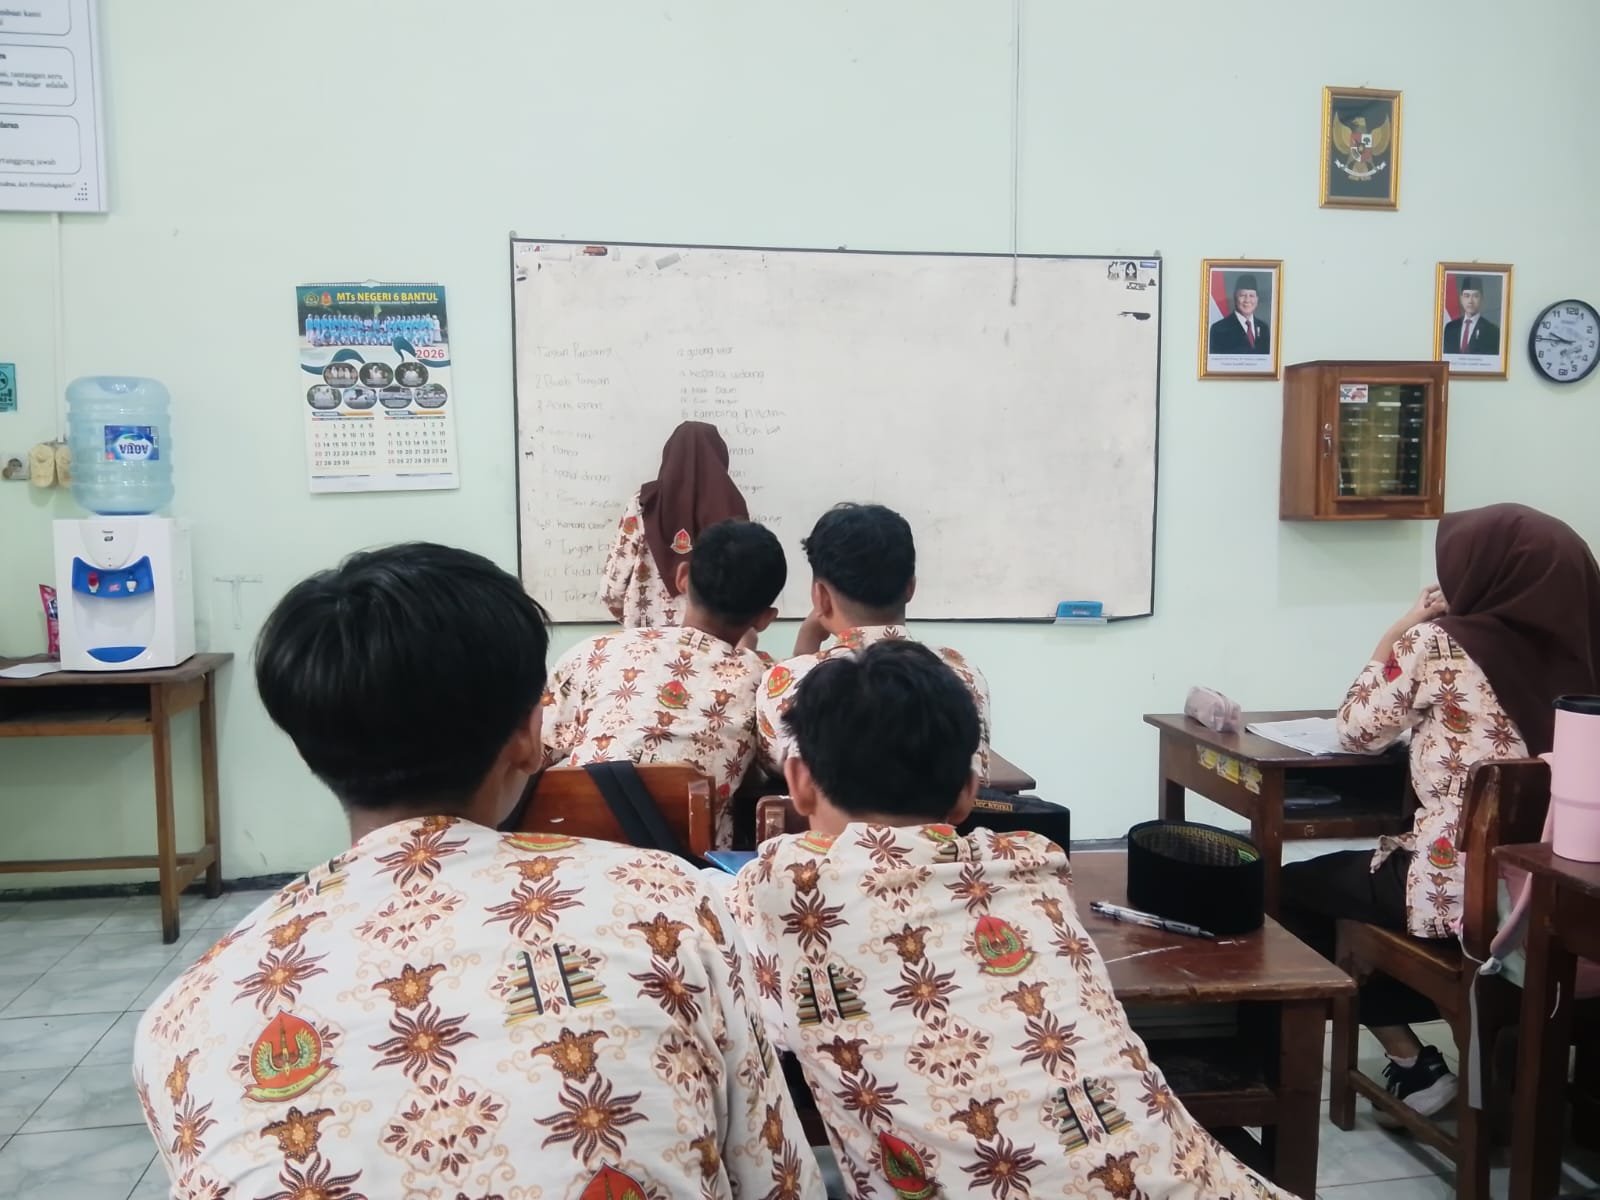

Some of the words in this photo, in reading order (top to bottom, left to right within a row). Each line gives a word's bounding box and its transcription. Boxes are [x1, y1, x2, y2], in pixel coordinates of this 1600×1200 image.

[337, 292, 355, 301] MTs
[357, 292, 391, 301] NEGERI
[393, 292, 399, 301] 6
[401, 292, 439, 301] BANTUL
[1552, 310, 1561, 318] 11
[1541, 321, 1551, 330] 10
[1587, 325, 1593, 334] 2
[1589, 340, 1595, 348] 3
[416, 349, 445, 359] 2026
[1546, 361, 1552, 370] 7
[1571, 364, 1578, 372] 5
[119, 442, 149, 454] AQUA
